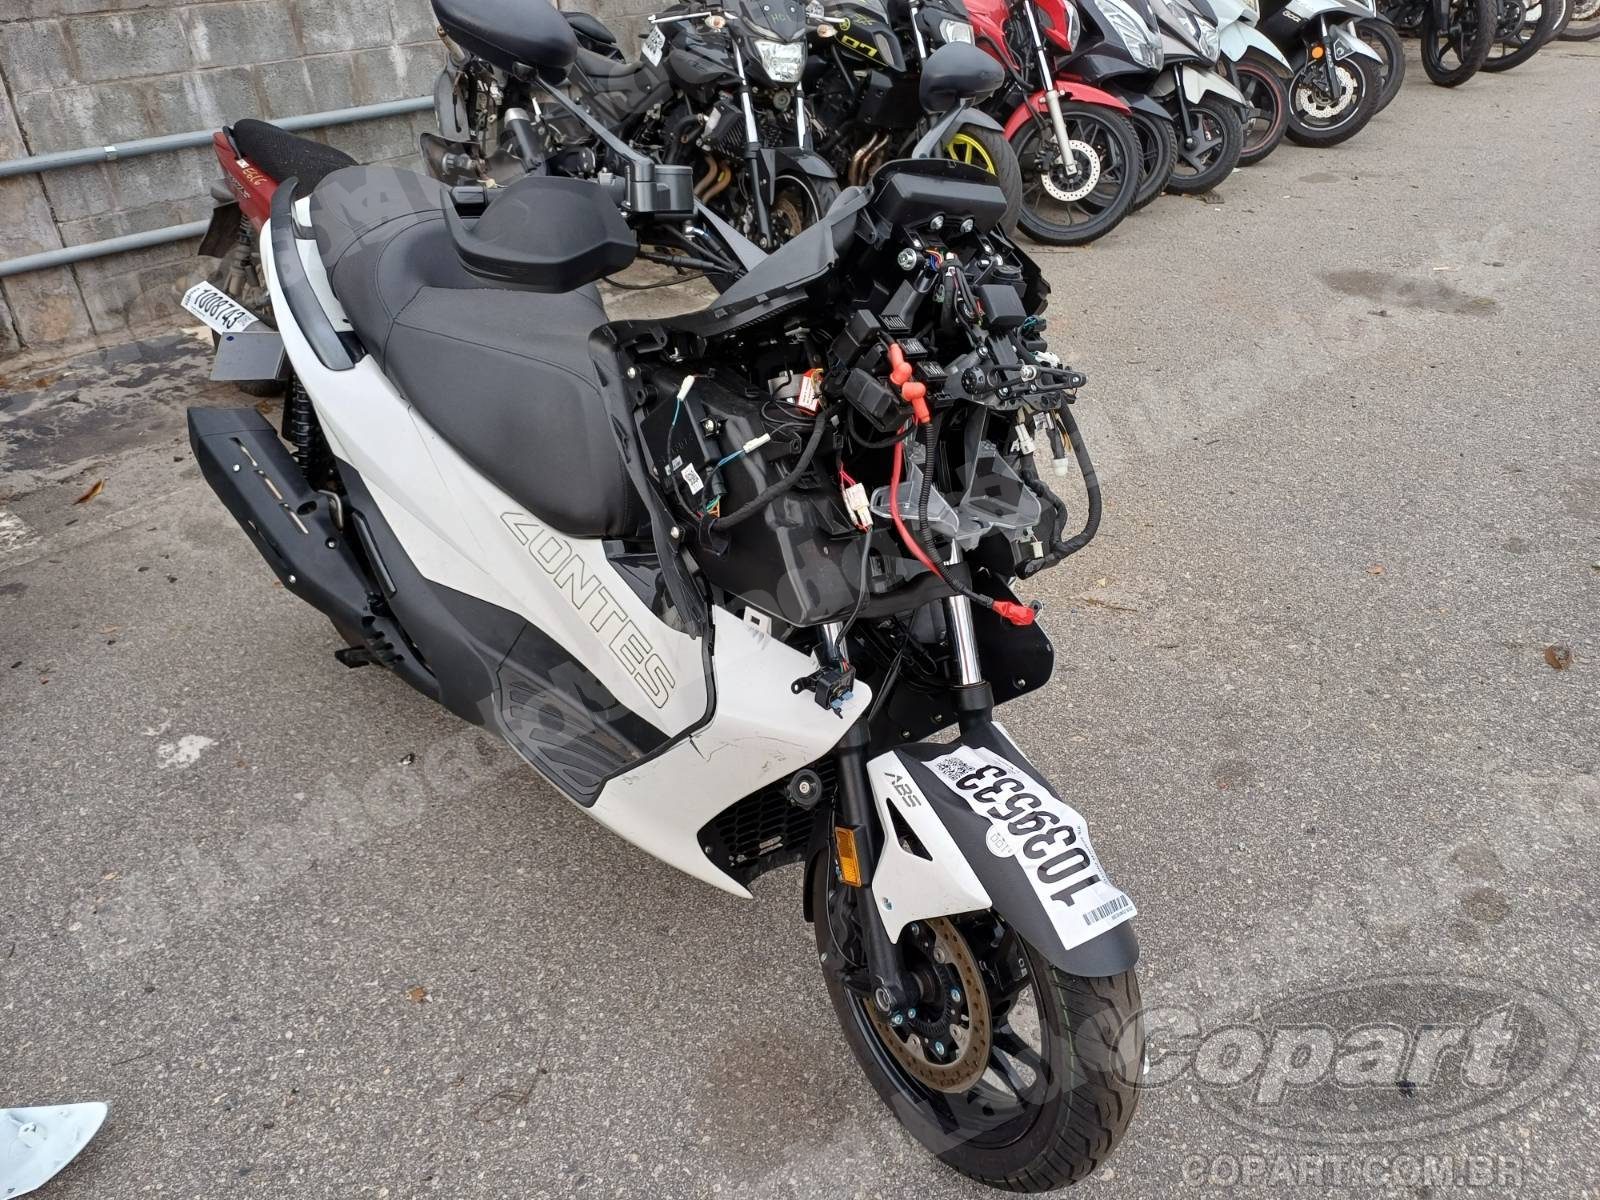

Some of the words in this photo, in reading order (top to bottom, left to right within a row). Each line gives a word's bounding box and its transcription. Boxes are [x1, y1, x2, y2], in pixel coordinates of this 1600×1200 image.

[841, 34, 878, 57] 07
[194, 289, 246, 330] 1008743
[499, 511, 676, 709] ZONTES
[884, 771, 922, 808] ABS
[955, 764, 1101, 908] 1039533
